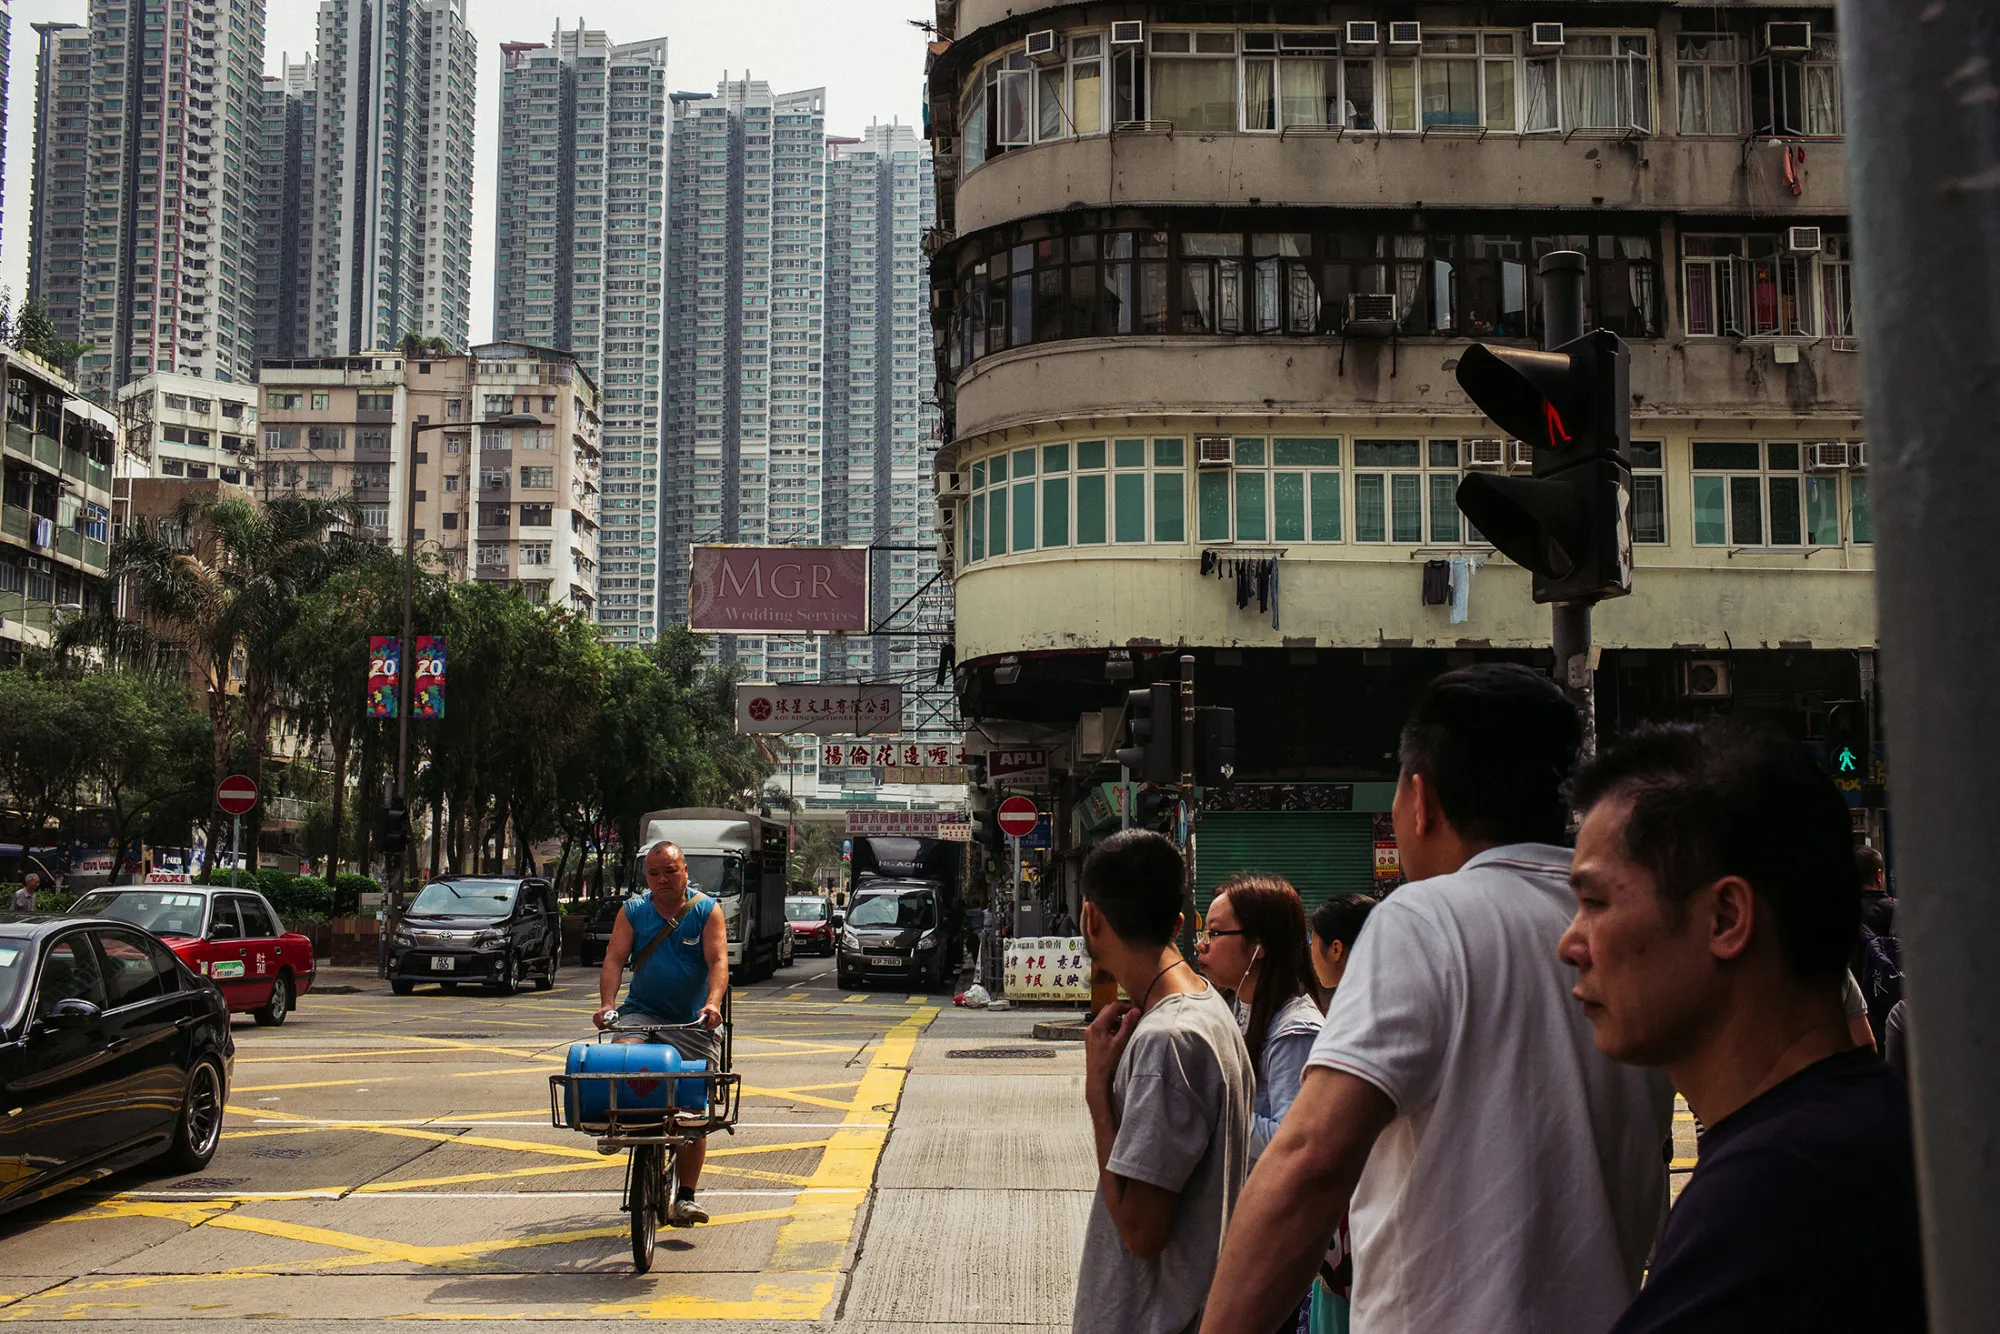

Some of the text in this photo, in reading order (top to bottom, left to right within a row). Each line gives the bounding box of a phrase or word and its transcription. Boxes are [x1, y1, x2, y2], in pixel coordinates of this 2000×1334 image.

[716, 555, 843, 599] MGR
[725, 607, 859, 624] Wedding Services
[369, 660, 396, 679] 20
[415, 660, 443, 679] 20
[775, 698, 890, 715] 球星文具有限公司
[1000, 752, 1043, 766] APLI
[149, 874, 186, 883] TAXI
[1025, 955, 1047, 970] 會見
[1056, 954, 1083, 970] 意見
[1024, 973, 1044, 988] 市民
[1052, 973, 1080, 988] 反映
